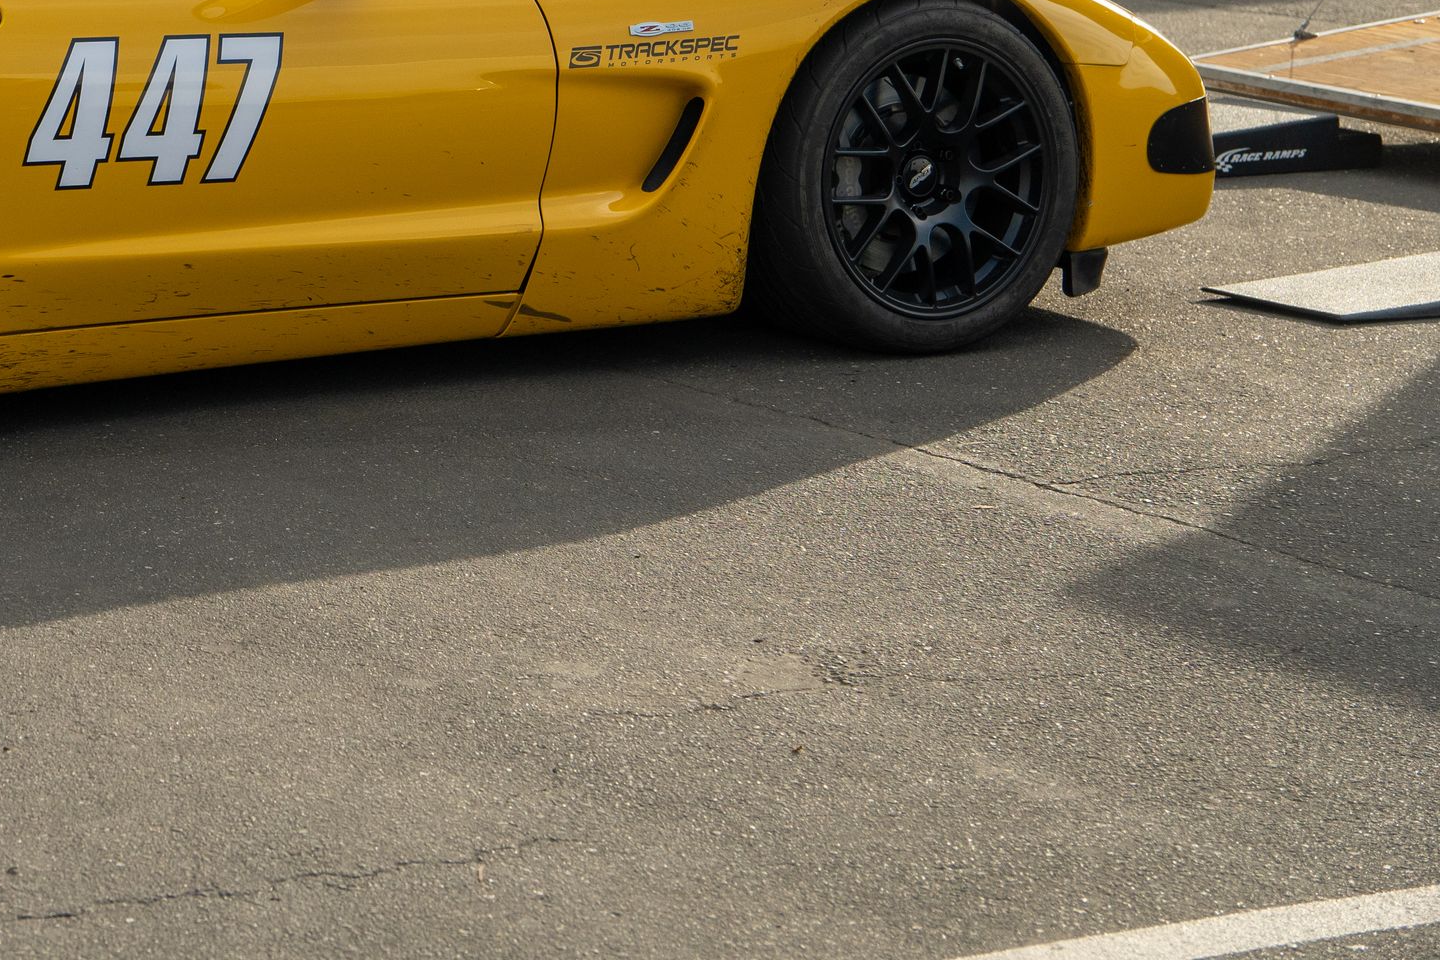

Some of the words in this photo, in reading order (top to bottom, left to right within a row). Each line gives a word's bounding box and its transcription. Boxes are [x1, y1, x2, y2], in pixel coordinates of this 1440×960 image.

[605, 35, 741, 61] TRACKSPEC
[607, 52, 738, 69] MOTORSPORTS
[22, 32, 284, 191] 447
[1230, 151, 1264, 164] RACE
[1262, 148, 1308, 161] RAMPS
